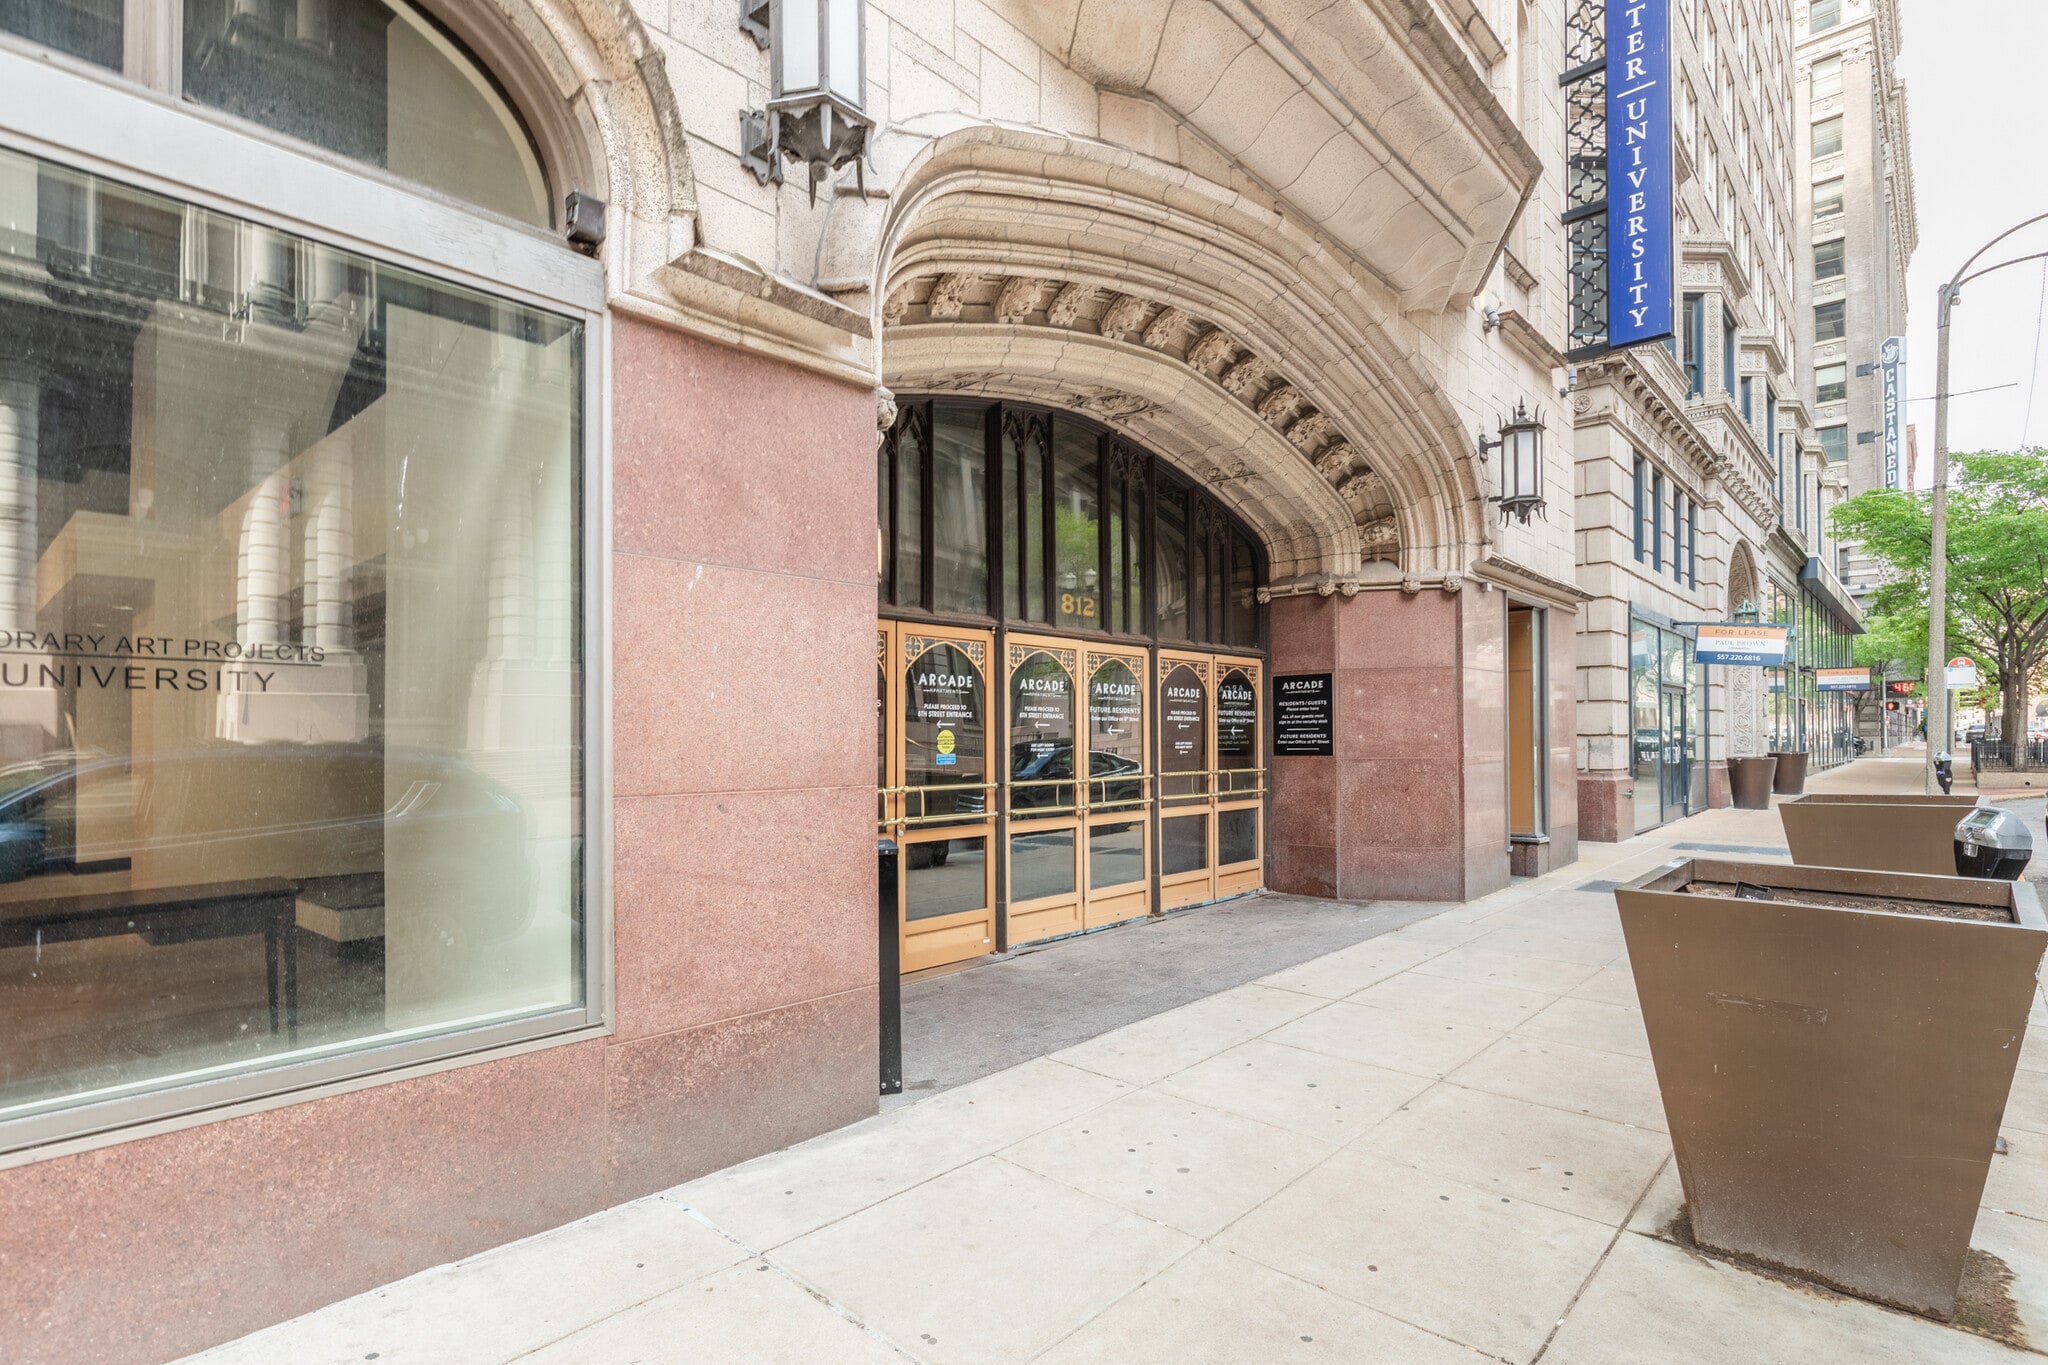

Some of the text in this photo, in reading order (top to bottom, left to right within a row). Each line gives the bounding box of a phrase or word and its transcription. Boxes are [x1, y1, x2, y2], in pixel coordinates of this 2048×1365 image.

[1625, 0, 1649, 328] TER UNIVERSITY
[1061, 593, 1095, 618] 812
[114, 636, 174, 656] ART
[184, 639, 326, 662] PROJECTS
[2, 662, 276, 692] UNIVERSITY
[918, 672, 973, 688] ARCADE
[1019, 678, 1065, 692] ARCADE
[1095, 682, 1136, 696] ARCADE
[1282, 680, 1324, 690] ARCADE
[1167, 687, 1200, 699] ARCADE
[1222, 689, 1252, 701] ARCADE
[928, 710, 946, 718] STREET
[945, 711, 973, 719] ENTRANCE
[1090, 706, 1141, 715] FUTURE RESIDENTS
